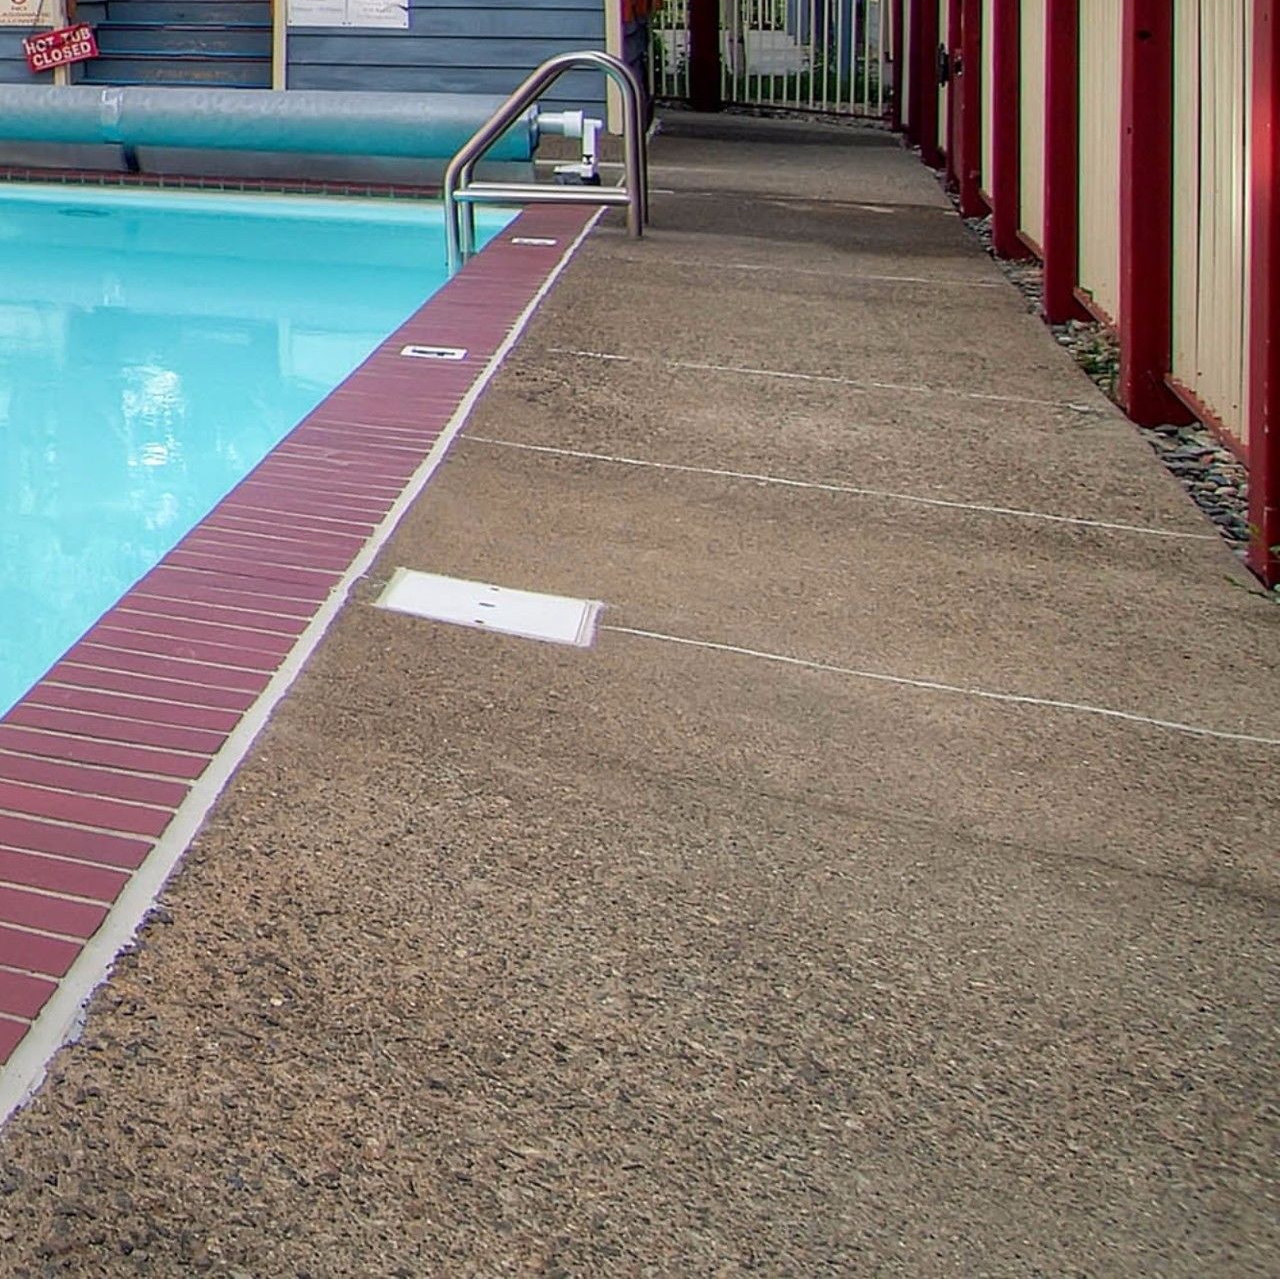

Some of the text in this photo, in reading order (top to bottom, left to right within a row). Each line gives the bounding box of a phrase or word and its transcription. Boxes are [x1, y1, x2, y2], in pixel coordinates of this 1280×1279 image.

[23, 28, 91, 54] HOT TUB
[33, 42, 91, 66] CLOSED
